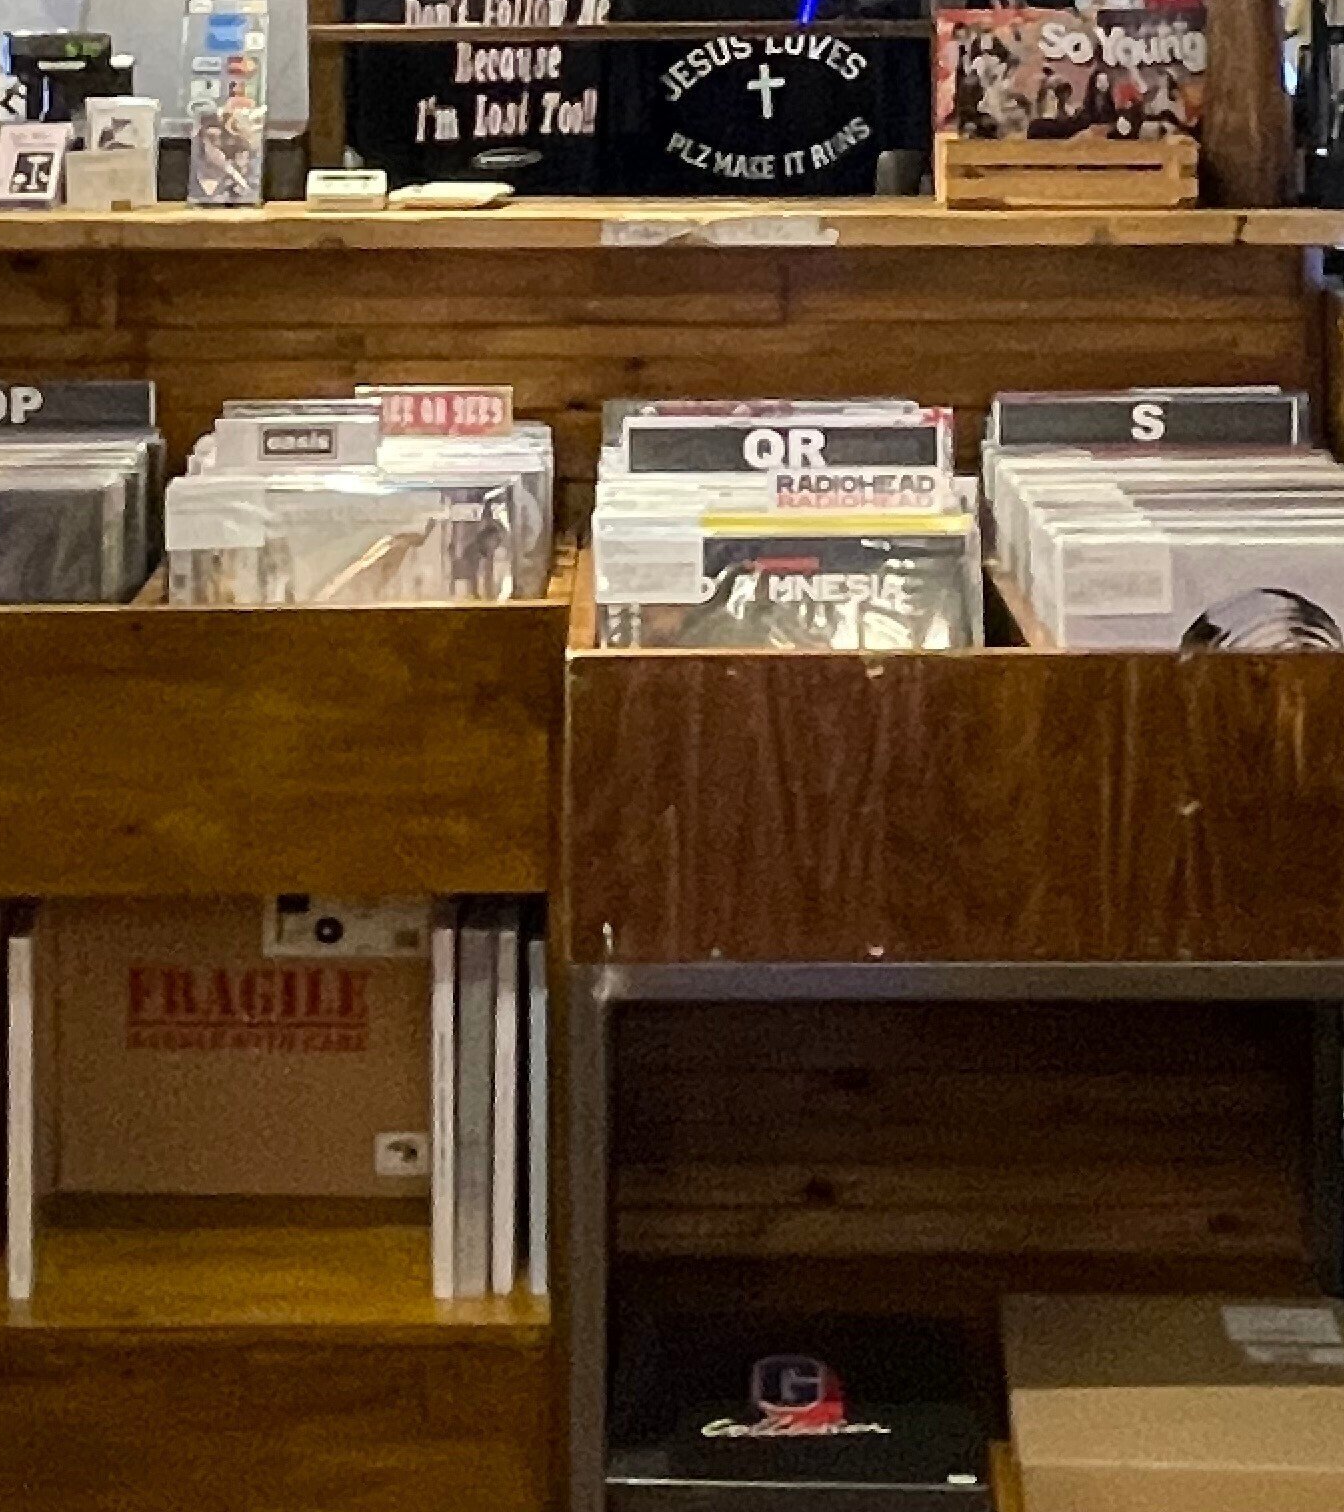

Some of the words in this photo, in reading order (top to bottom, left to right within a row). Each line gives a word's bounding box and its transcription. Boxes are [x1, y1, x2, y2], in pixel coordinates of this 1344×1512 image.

[454, 41, 563, 83] Because
[660, 34, 754, 102] JESUS
[764, 33, 868, 80] LOVES
[1038, 22, 1096, 66] So
[1095, 24, 1208, 74] Young
[415, 94, 460, 143] I'm
[473, 90, 530, 137] Lost
[665, 131, 711, 170] PLZ
[712, 149, 776, 179] MAKE
[784, 150, 806, 178] IT
[1130, 404, 1167, 442] S
[742, 428, 827, 468] QR
[775, 474, 935, 494] RADIOHEAD
[128, 966, 373, 1017] FRAGILE
